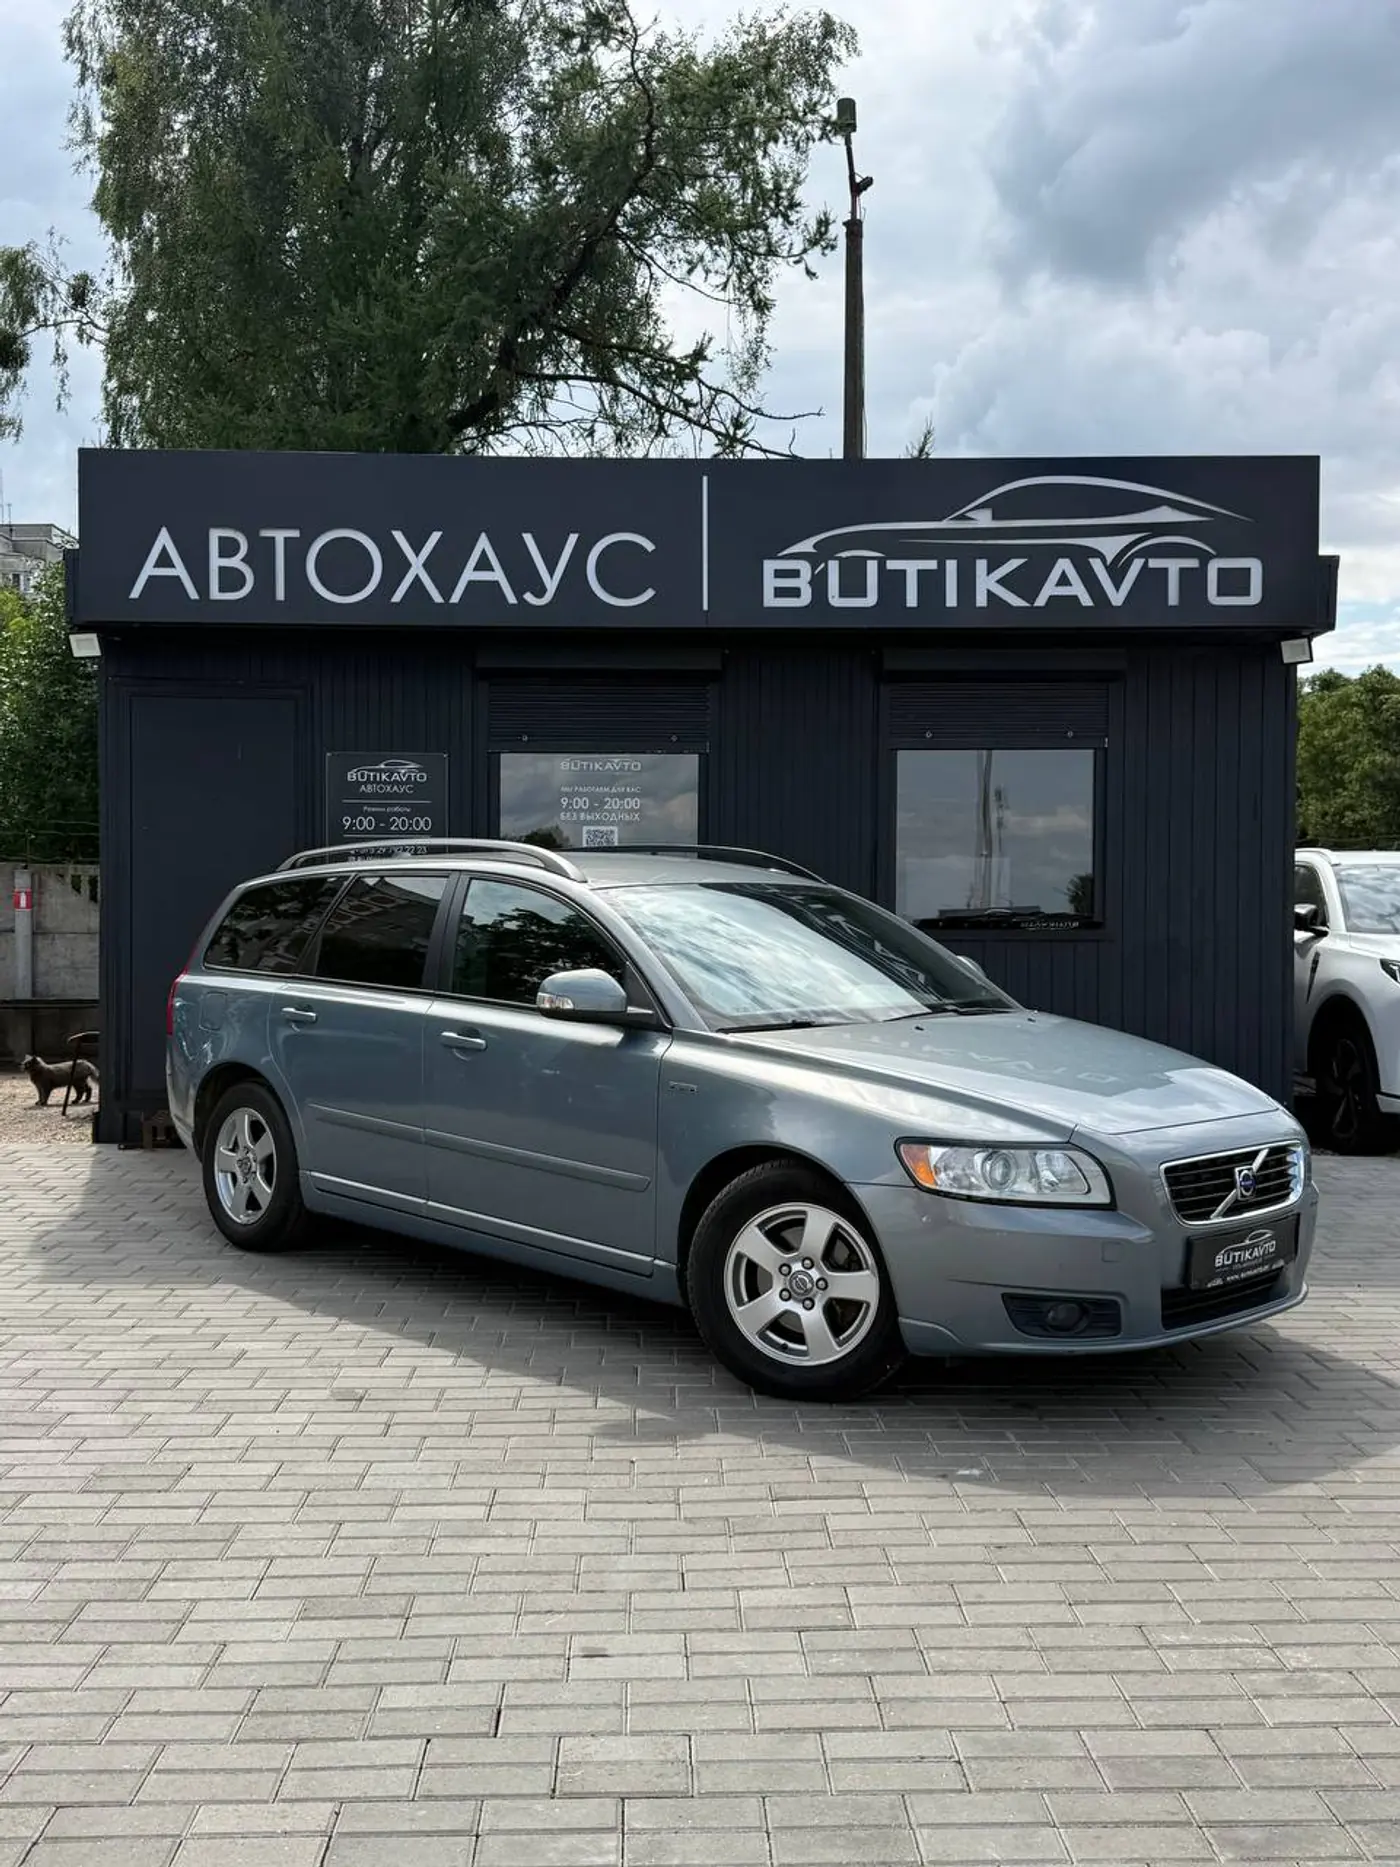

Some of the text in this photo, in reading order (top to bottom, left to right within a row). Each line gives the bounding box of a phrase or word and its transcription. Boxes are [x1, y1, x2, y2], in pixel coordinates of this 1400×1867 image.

[128, 526, 656, 607] АВТОХАУС
[762, 556, 1263, 608] BUTIKAVTO
[560, 760, 641, 771] BUTIKAVTO
[347, 771, 427, 782] BUTIKAVTO
[360, 784, 414, 794] АВТОХАУС
[561, 797, 589, 809] 9:00
[604, 797, 641, 809] 20:00
[342, 816, 375, 830] 9:00
[389, 816, 432, 831] 20:00
[1214, 1240, 1276, 1268] BUTIKAVTO
